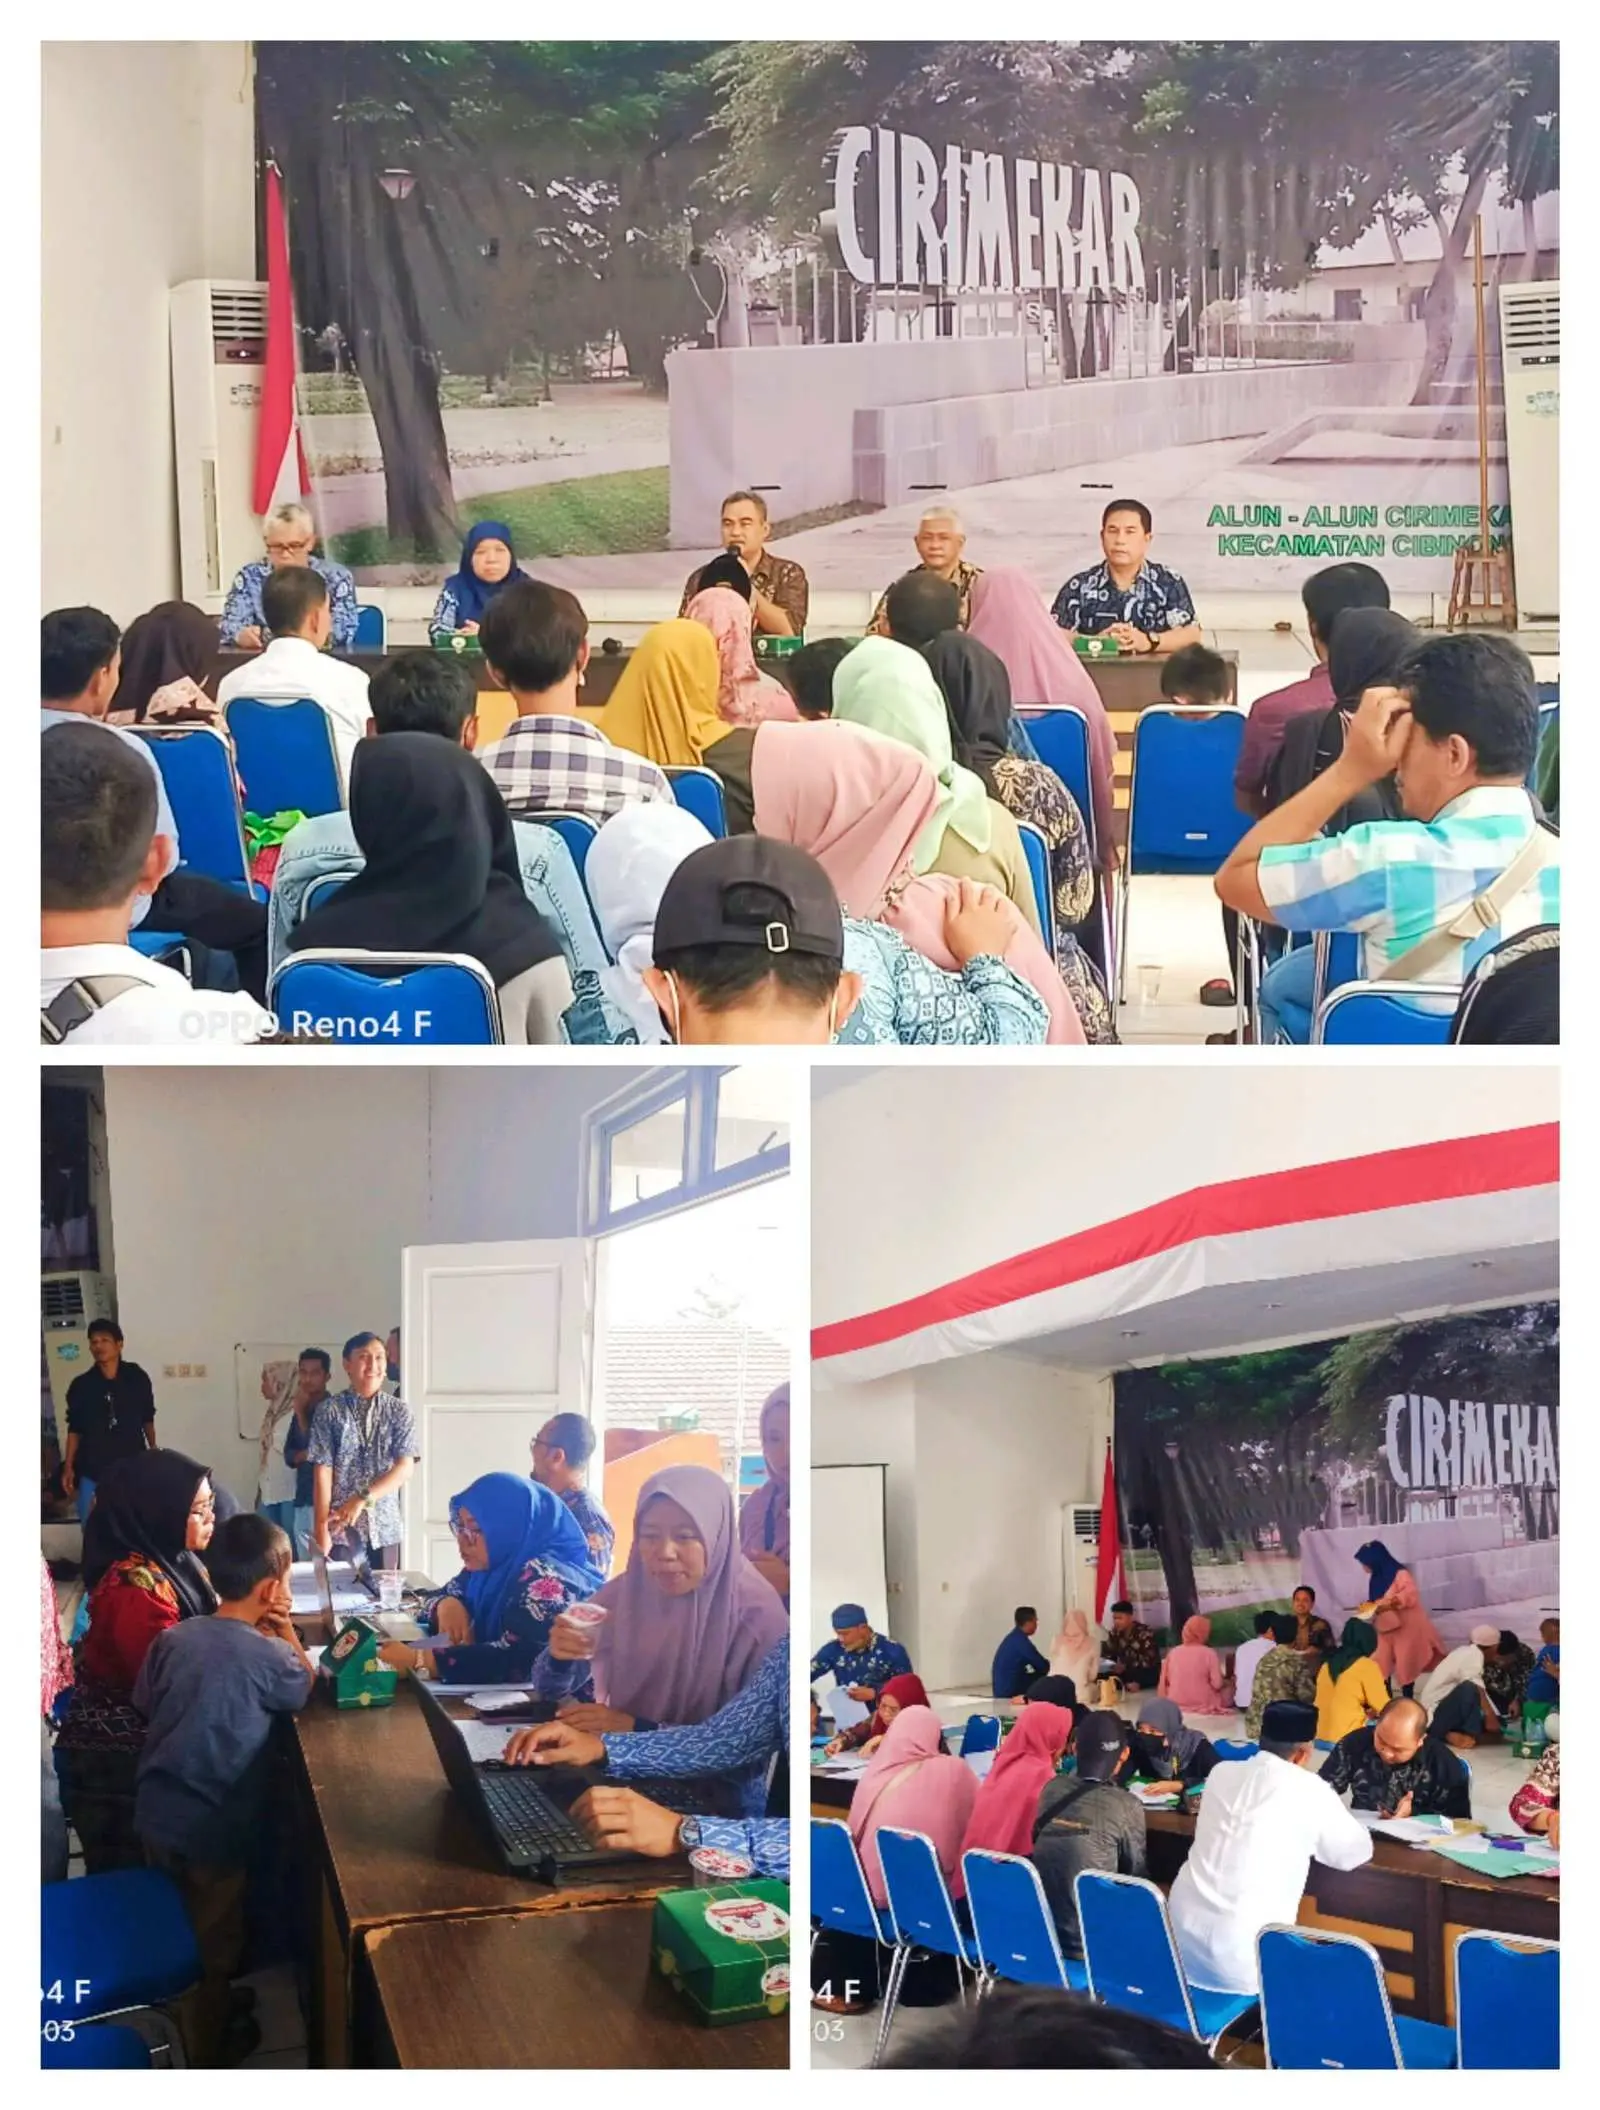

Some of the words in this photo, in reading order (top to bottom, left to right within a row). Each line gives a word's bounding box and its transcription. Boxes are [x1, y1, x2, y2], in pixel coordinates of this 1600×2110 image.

[836, 126, 1146, 294] CIRIMEKAR
[1207, 505, 1281, 527] ALUN
[1303, 505, 1378, 527] ALUN
[1218, 535, 1385, 557] KECAMATAN
[1386, 1394, 1560, 1487] CIRIMEKA
